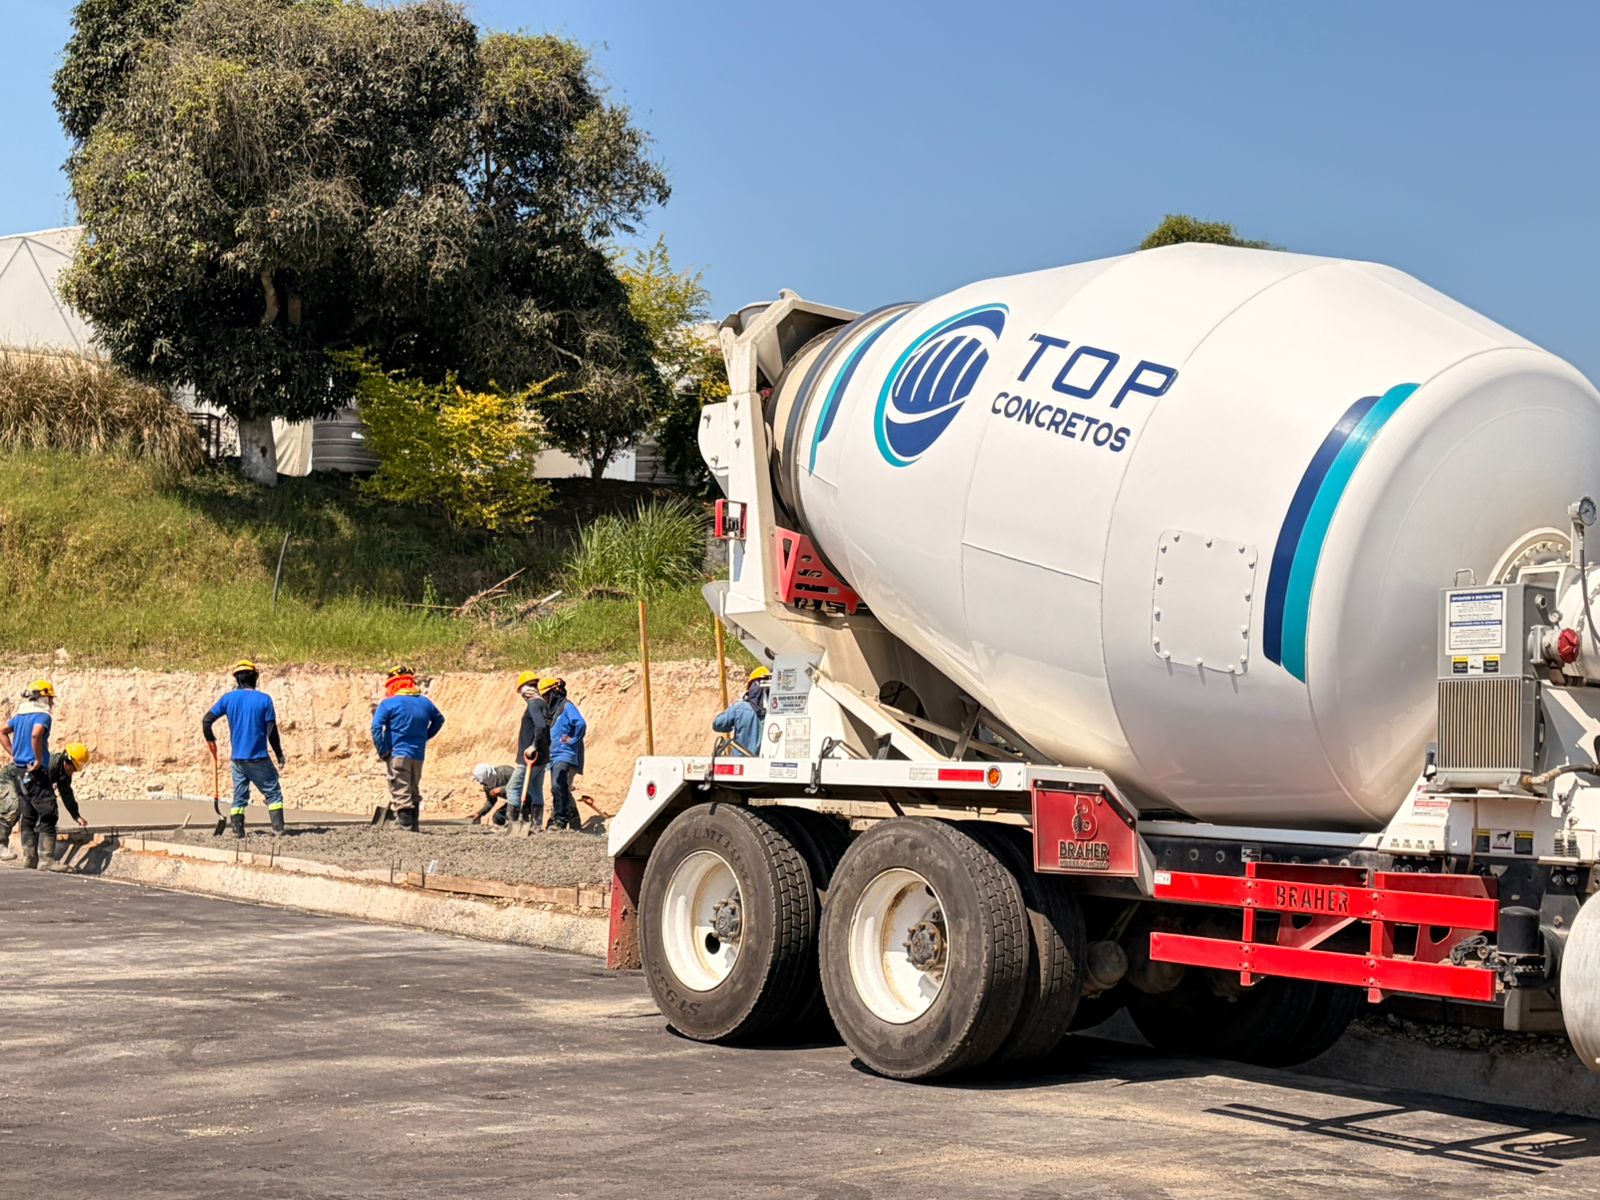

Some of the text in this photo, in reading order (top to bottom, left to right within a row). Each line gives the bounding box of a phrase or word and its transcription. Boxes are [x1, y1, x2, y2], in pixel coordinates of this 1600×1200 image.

[1016, 332, 1180, 410] TOP
[991, 391, 1131, 453] CONCRETOS
[1058, 840, 1109, 860] BRAHER
[1276, 884, 1349, 913] BRAHER
